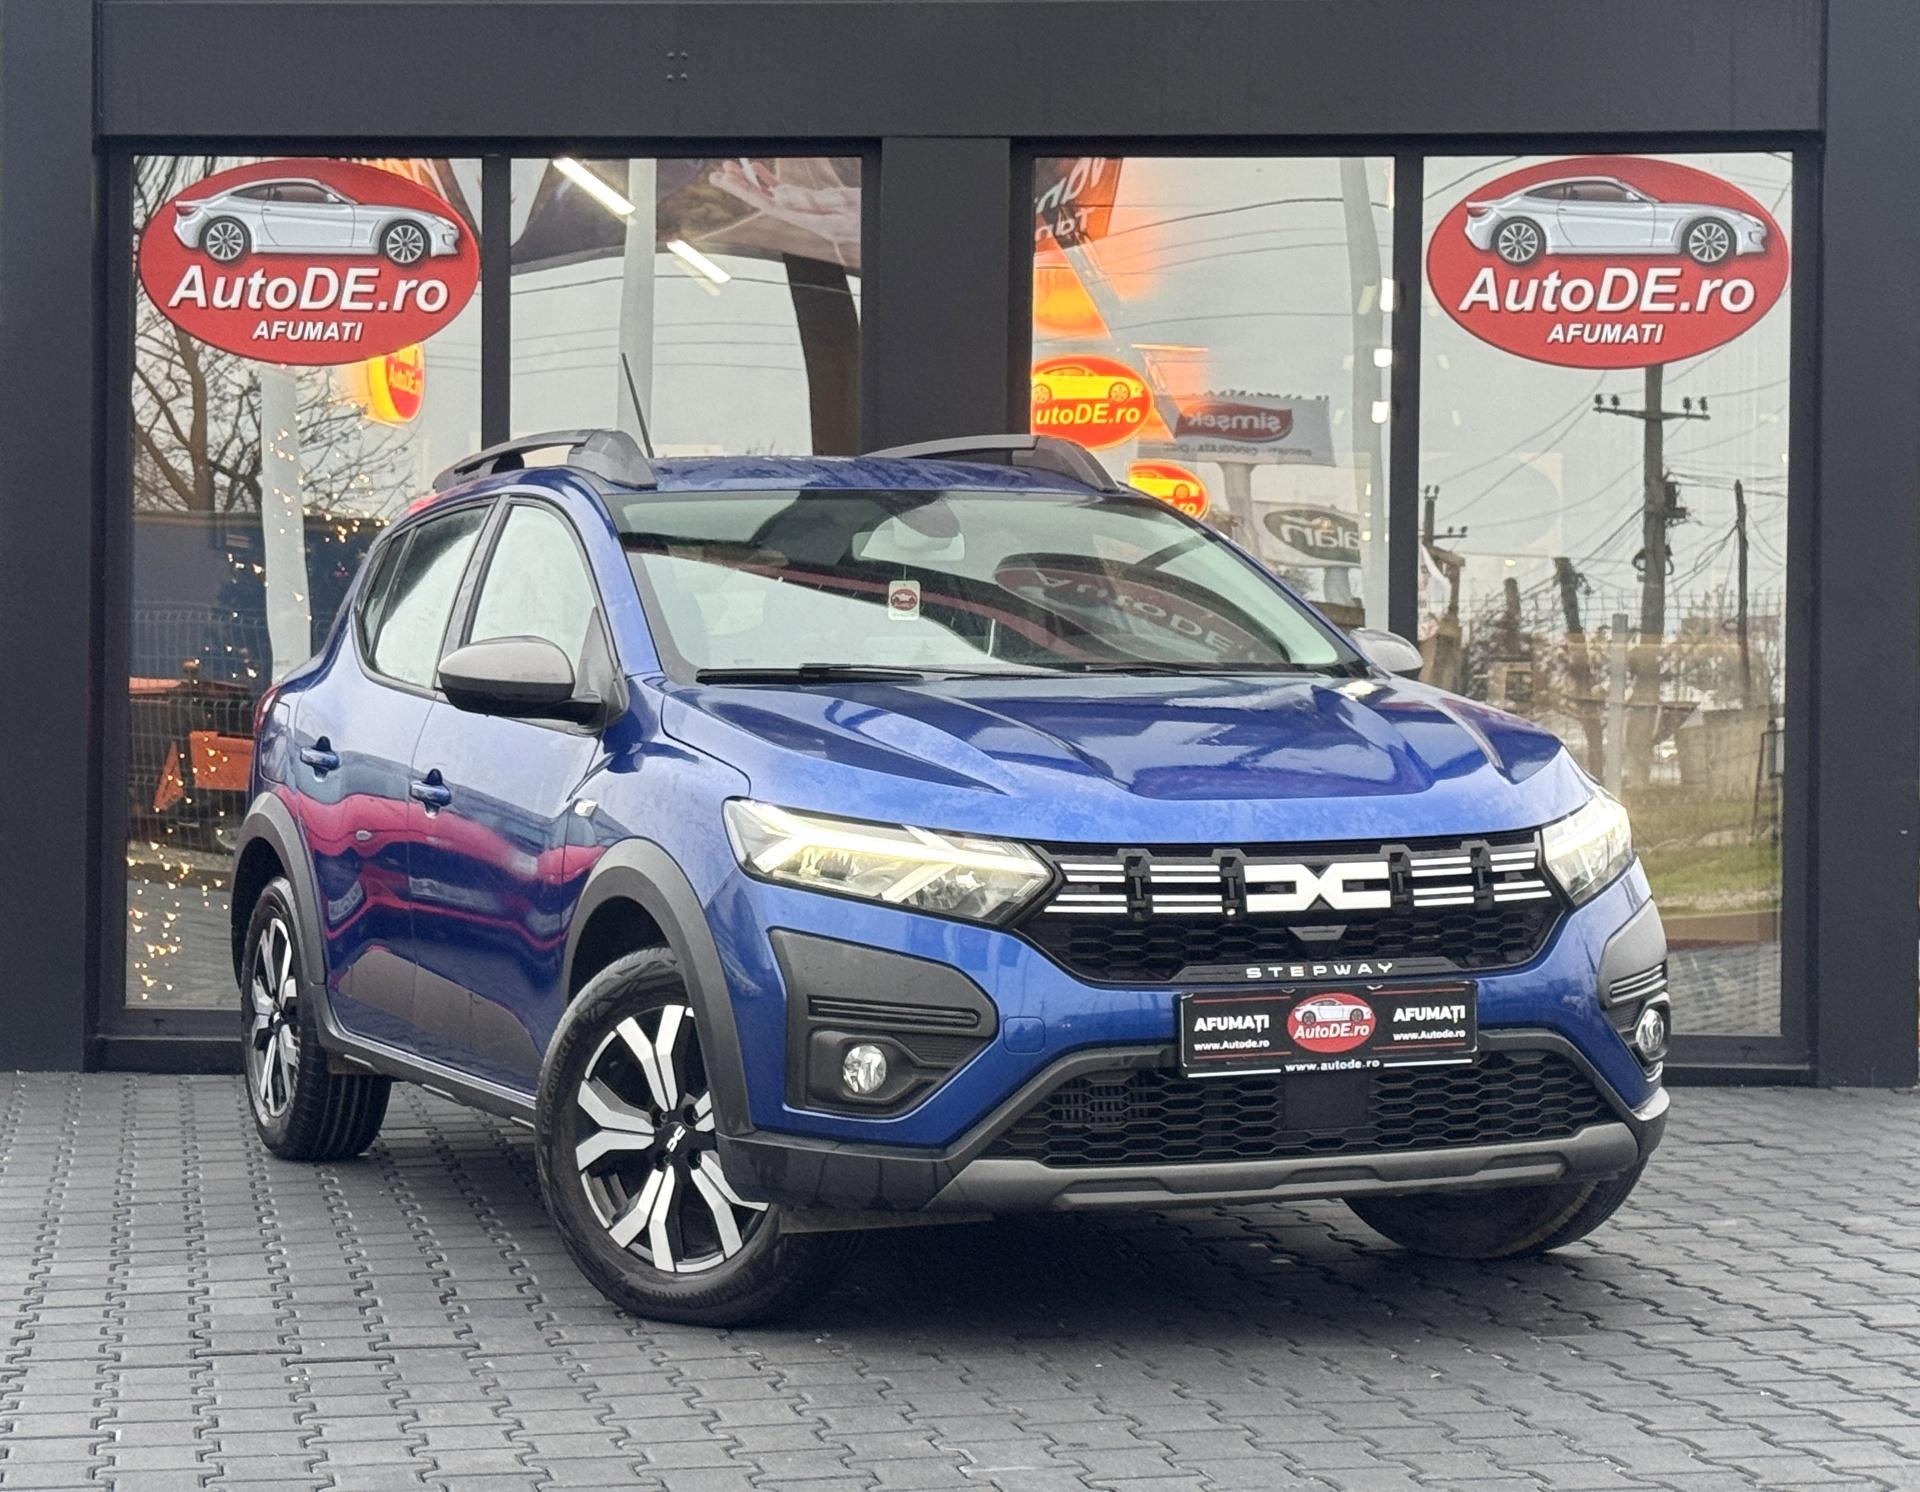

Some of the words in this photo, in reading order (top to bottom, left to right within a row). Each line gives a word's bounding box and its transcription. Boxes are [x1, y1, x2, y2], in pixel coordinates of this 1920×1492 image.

[168, 264, 449, 313] AutoDE.ro
[1458, 266, 1756, 315] AutoDE.ro
[251, 320, 364, 342] AFUMATI
[1546, 322, 1666, 345] AFUMATI
[1036, 402, 1141, 425] utoDE.ro
[1246, 961, 1393, 979] STEPWAY
[1293, 1021, 1370, 1040] AutoDE.ro
[1285, 1058, 1380, 1072] www.autode.ro
